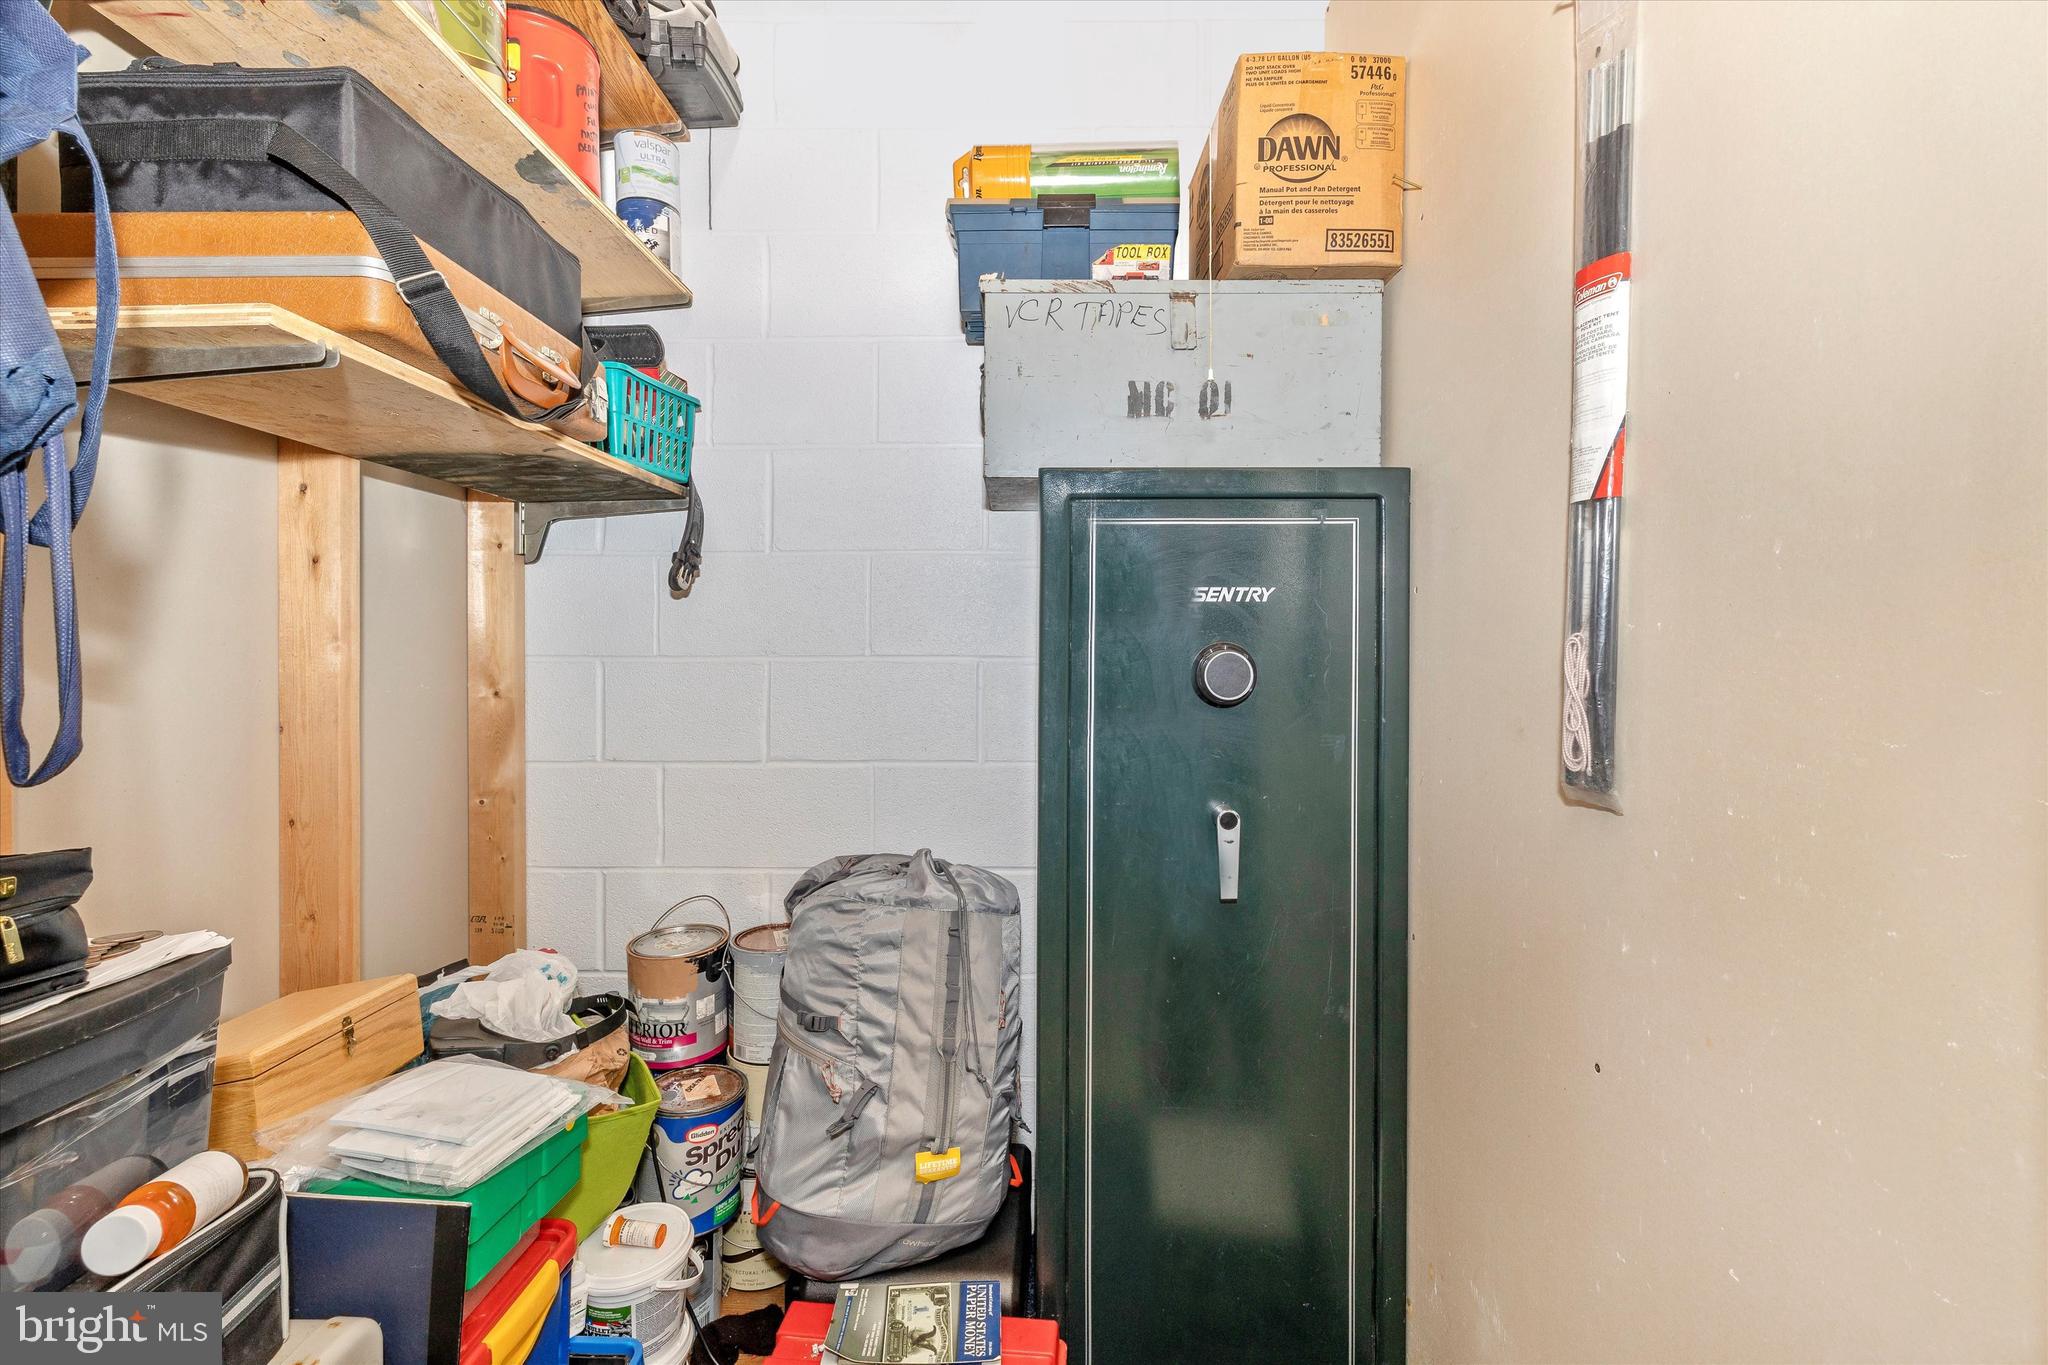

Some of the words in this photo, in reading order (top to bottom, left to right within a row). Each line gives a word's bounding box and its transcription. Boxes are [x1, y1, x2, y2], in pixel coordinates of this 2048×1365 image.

[1350, 65, 1392, 80] 57446
[634, 138, 672, 156] valspar
[1257, 135, 1341, 162] DAWN
[640, 152, 667, 165] ULTRA
[1118, 162, 1168, 176] Remington
[1262, 164, 1336, 173] PROFESSIONAL
[1330, 232, 1390, 249] 83526551
[1116, 246, 1141, 259] TOOL
[1146, 246, 1169, 259] BOX
[1576, 282, 1608, 302] Coleman
[1006, 298, 1064, 331] VCR
[1074, 300, 1168, 336] TAPES
[1192, 586, 1276, 602] SENTRY
[690, 1129, 715, 1140] Glidden
[966, 1284, 977, 1319] PAPER
[976, 1284, 987, 1320] UNITED
[964, 1320, 976, 1357] MONEY
[976, 1321, 986, 1357] STATES
